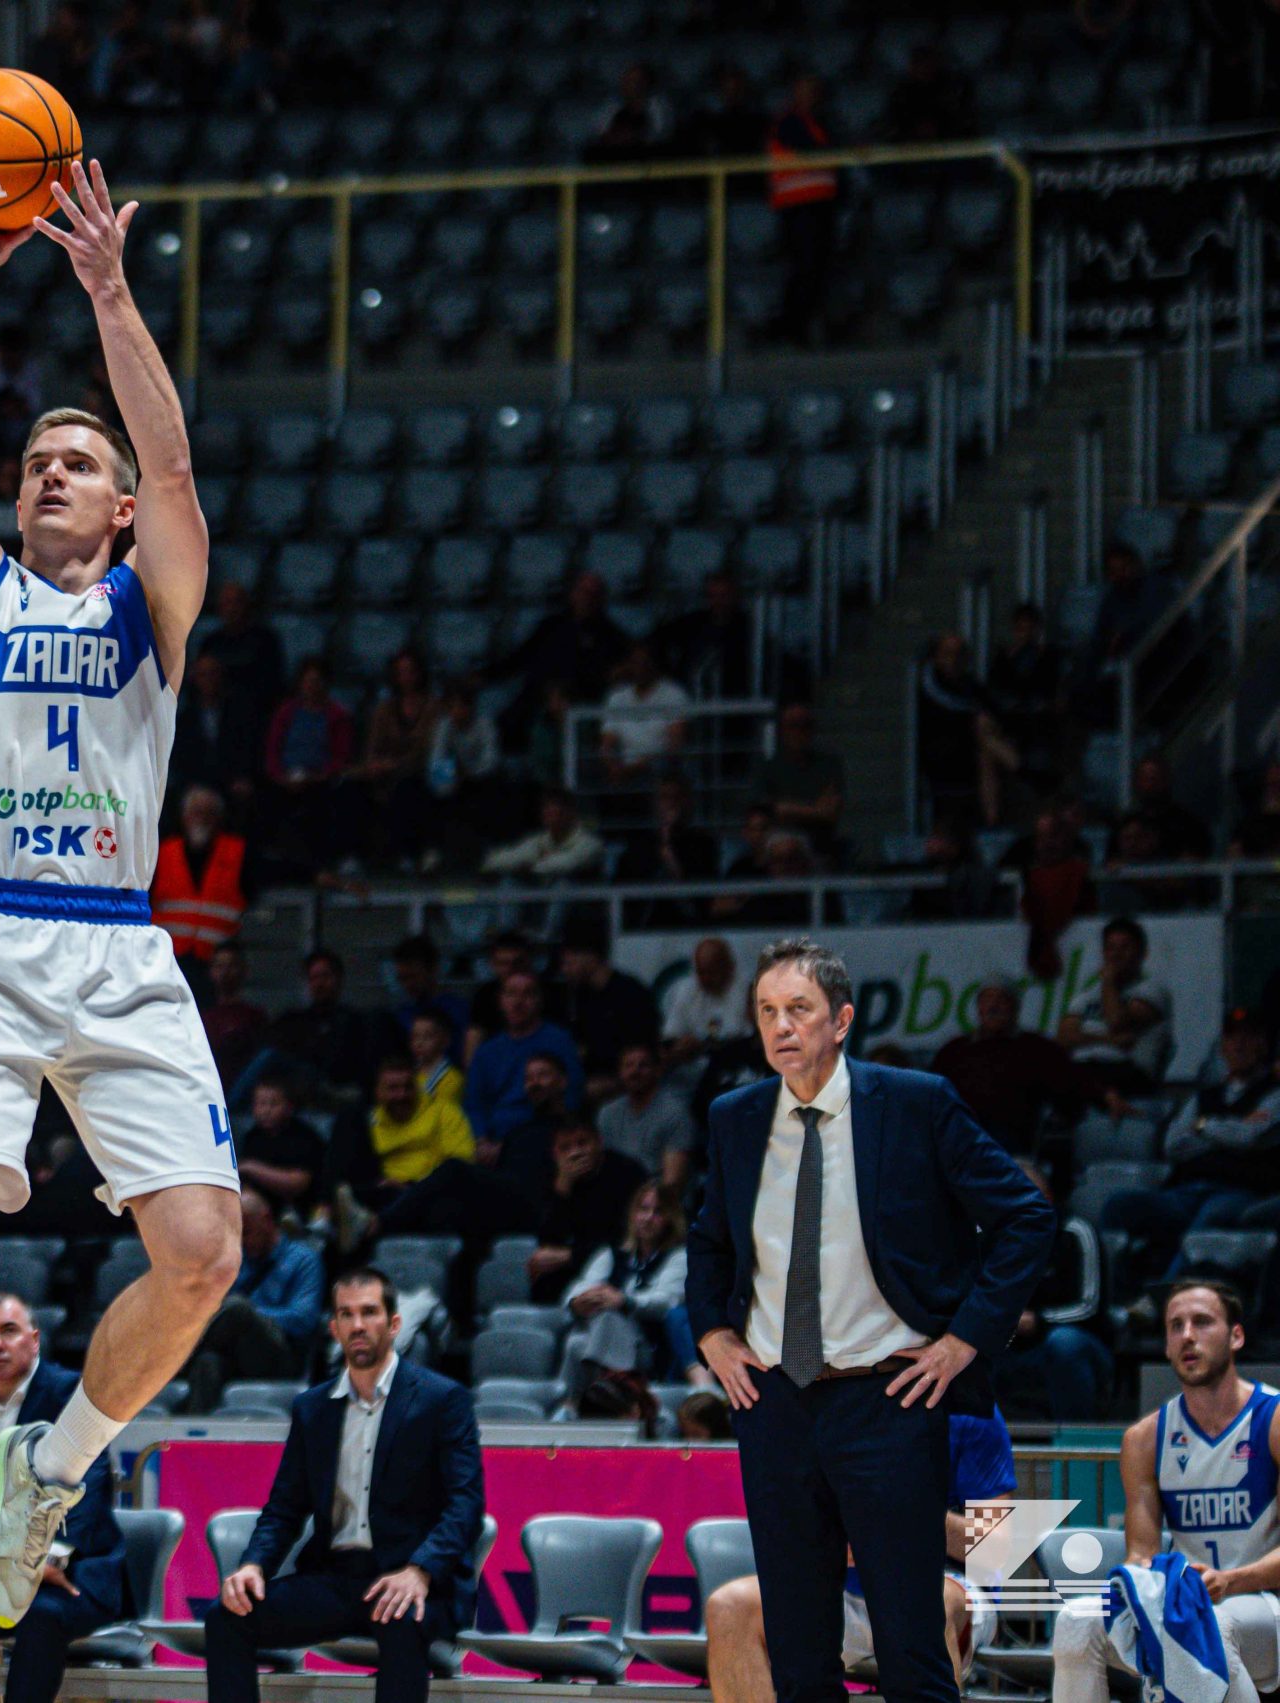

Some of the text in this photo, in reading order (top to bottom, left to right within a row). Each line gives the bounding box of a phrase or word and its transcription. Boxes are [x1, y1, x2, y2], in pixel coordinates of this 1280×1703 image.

[2, 631, 120, 690] ZADAR
[47, 705, 80, 772] 4
[11, 825, 92, 857] PSK
[208, 1104, 237, 1169] 4
[1176, 1490, 1252, 1527] ZADAR
